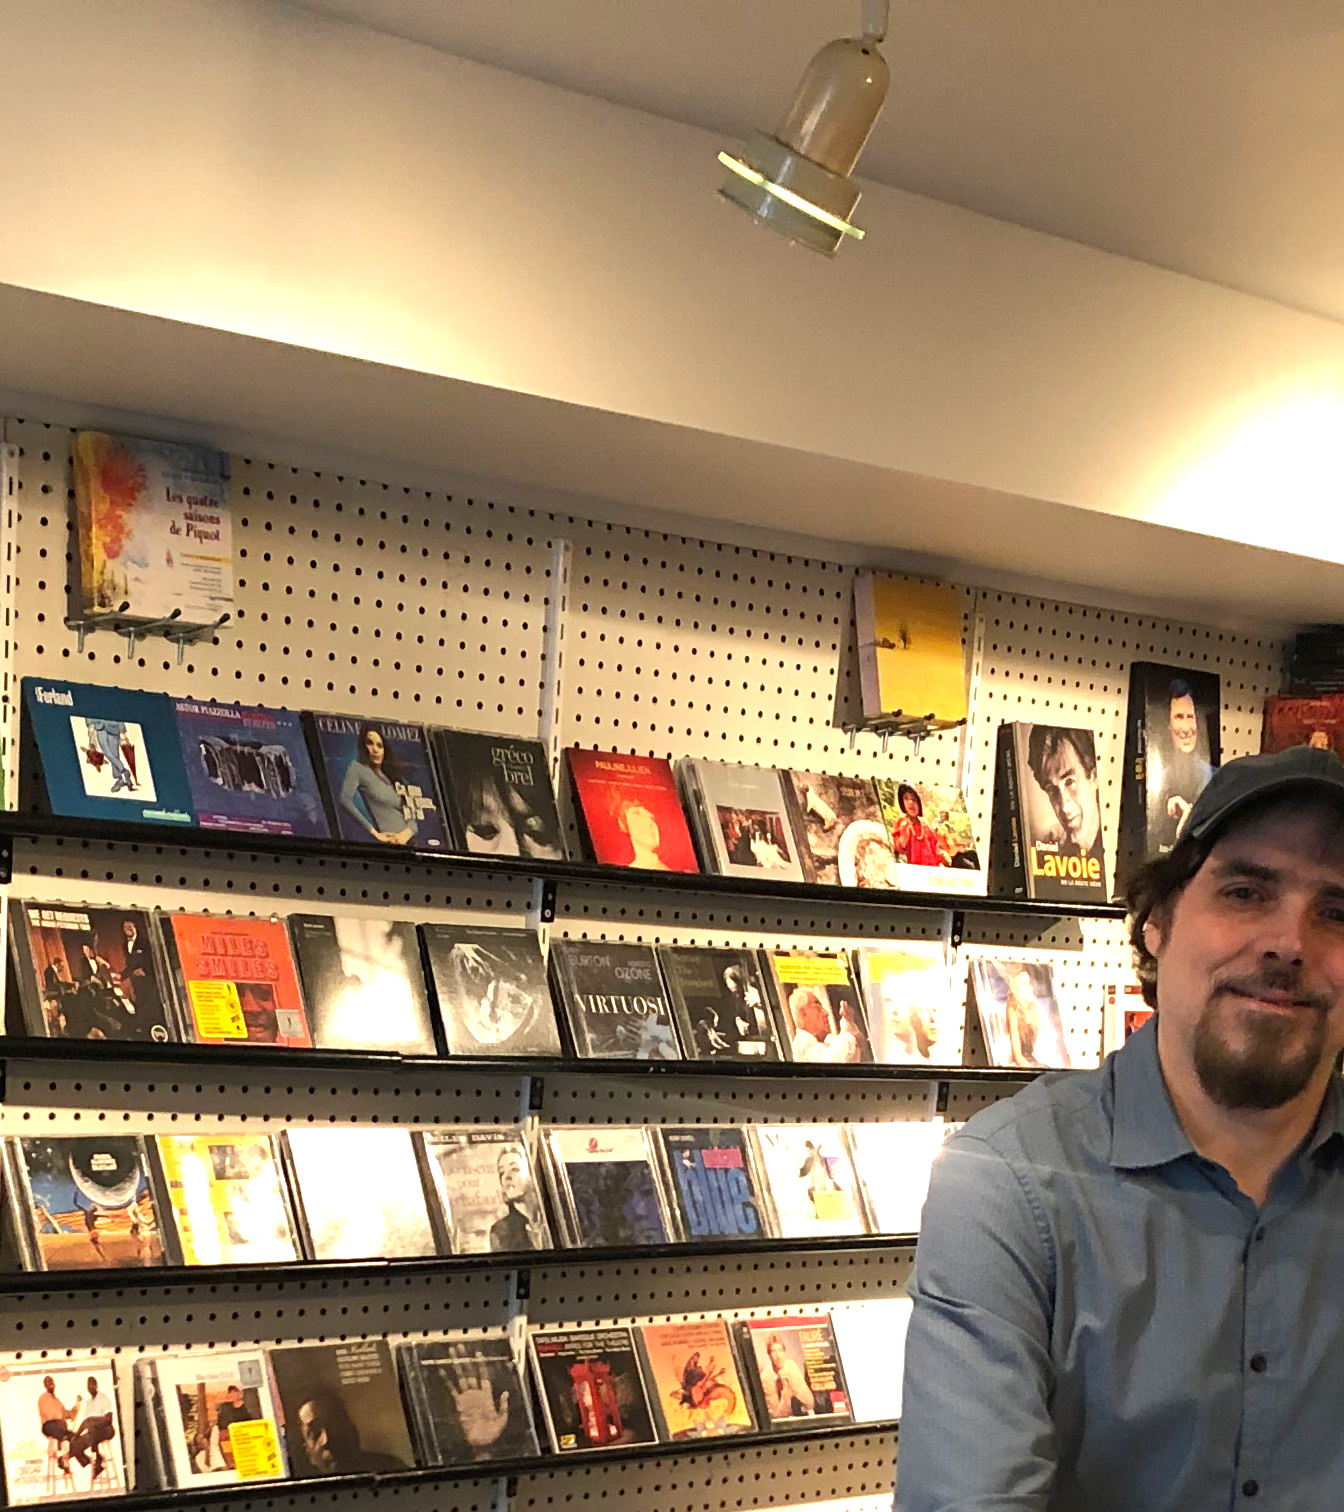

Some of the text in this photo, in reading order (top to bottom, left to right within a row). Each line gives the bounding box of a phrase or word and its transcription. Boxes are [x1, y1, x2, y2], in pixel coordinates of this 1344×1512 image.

[166, 487, 219, 510] Les quatre
[184, 510, 221, 525] saisons
[169, 520, 221, 544] de Piquot
[381, 724, 421, 743] LOMEZ
[490, 744, 534, 767] gréco
[503, 768, 534, 787] brel
[1035, 841, 1059, 852] Daniel
[1031, 847, 1101, 879] Lavoie
[201, 934, 270, 957] MILES
[197, 957, 280, 980] SMILES
[568, 954, 612, 968] BURTON
[614, 967, 652, 980] OZONE
[574, 993, 666, 1016] VIRTUOSI
[676, 1149, 758, 1236] blue
